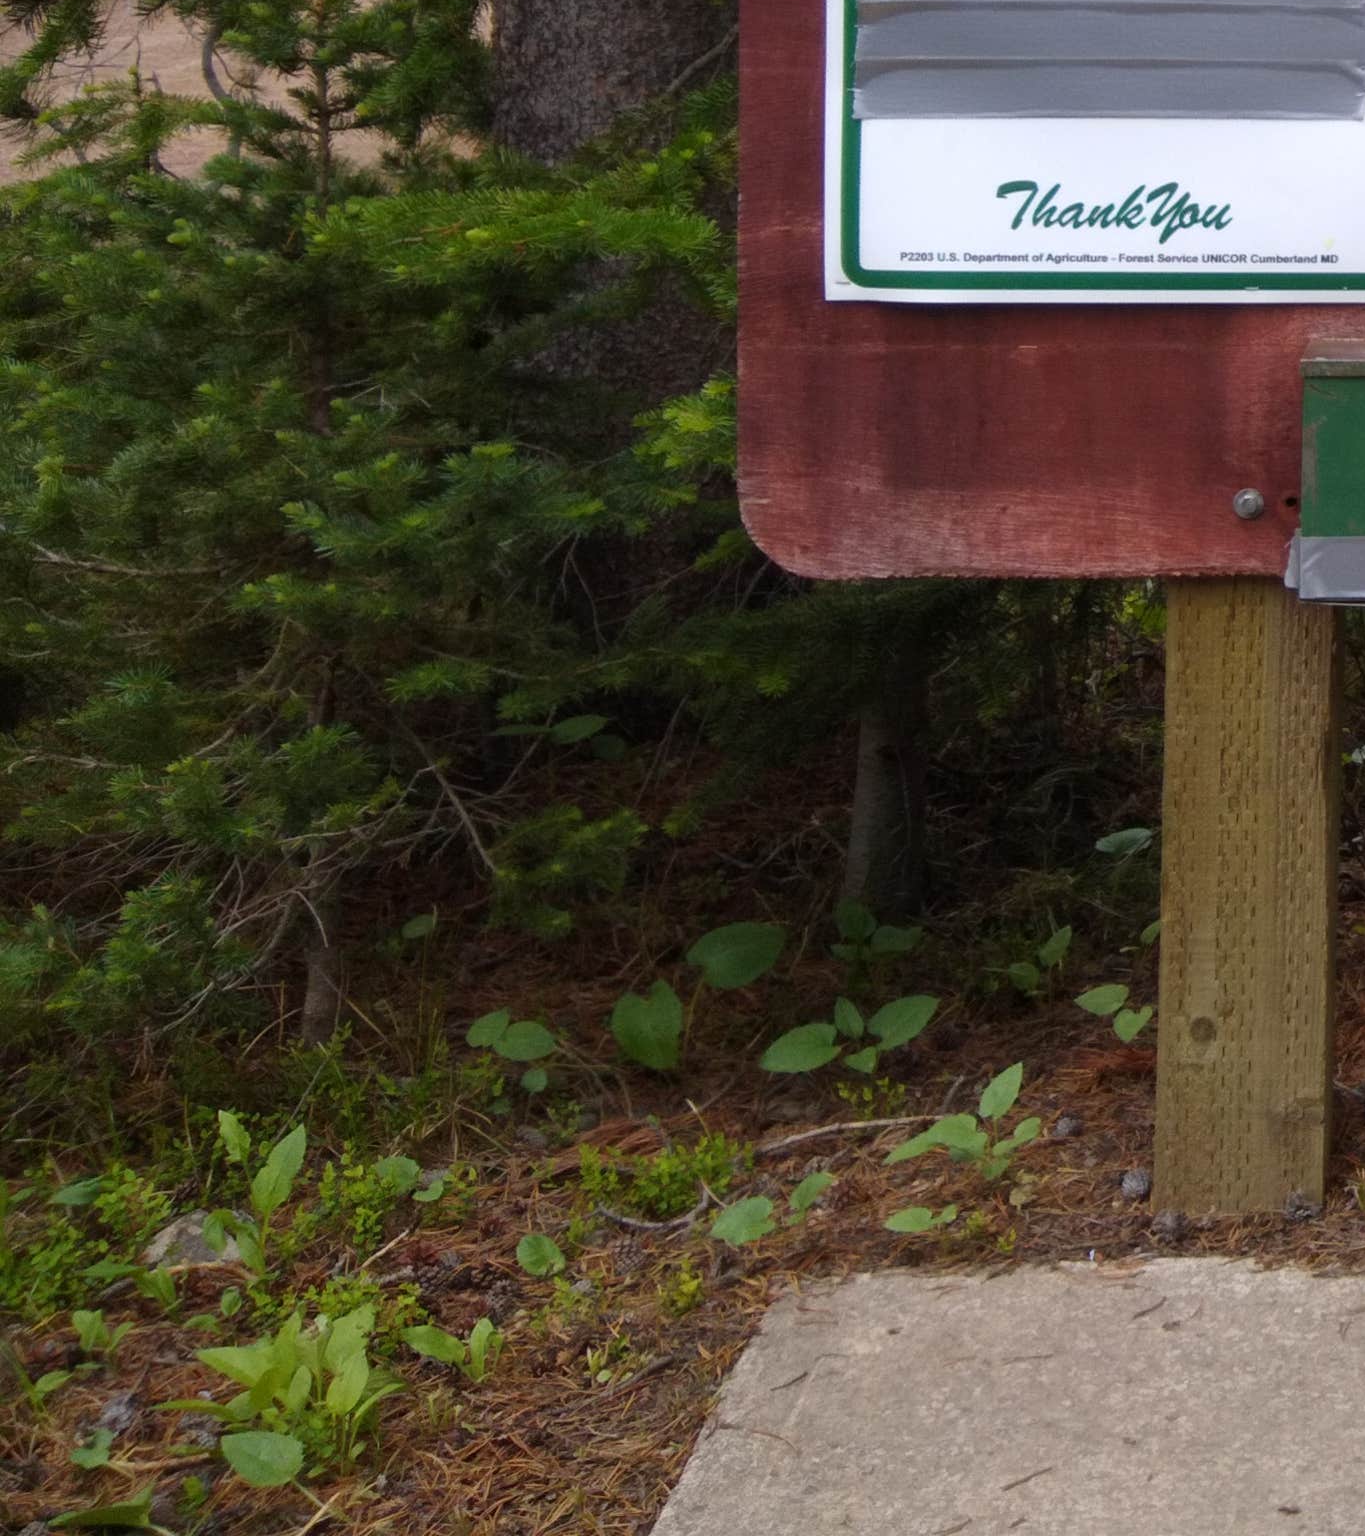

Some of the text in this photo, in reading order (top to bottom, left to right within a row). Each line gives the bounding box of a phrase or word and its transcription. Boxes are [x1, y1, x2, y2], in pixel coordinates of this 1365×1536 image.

[963, 252, 1028, 263] Department
[1031, 253, 1043, 262] of
[1045, 253, 1108, 264] Agriculture
[1118, 253, 1154, 262] Forest
[1157, 253, 1198, 263] Service
[1202, 254, 1246, 263] UNICOR
[1250, 254, 1317, 263] Cumberland
[1320, 254, 1338, 263] MD
